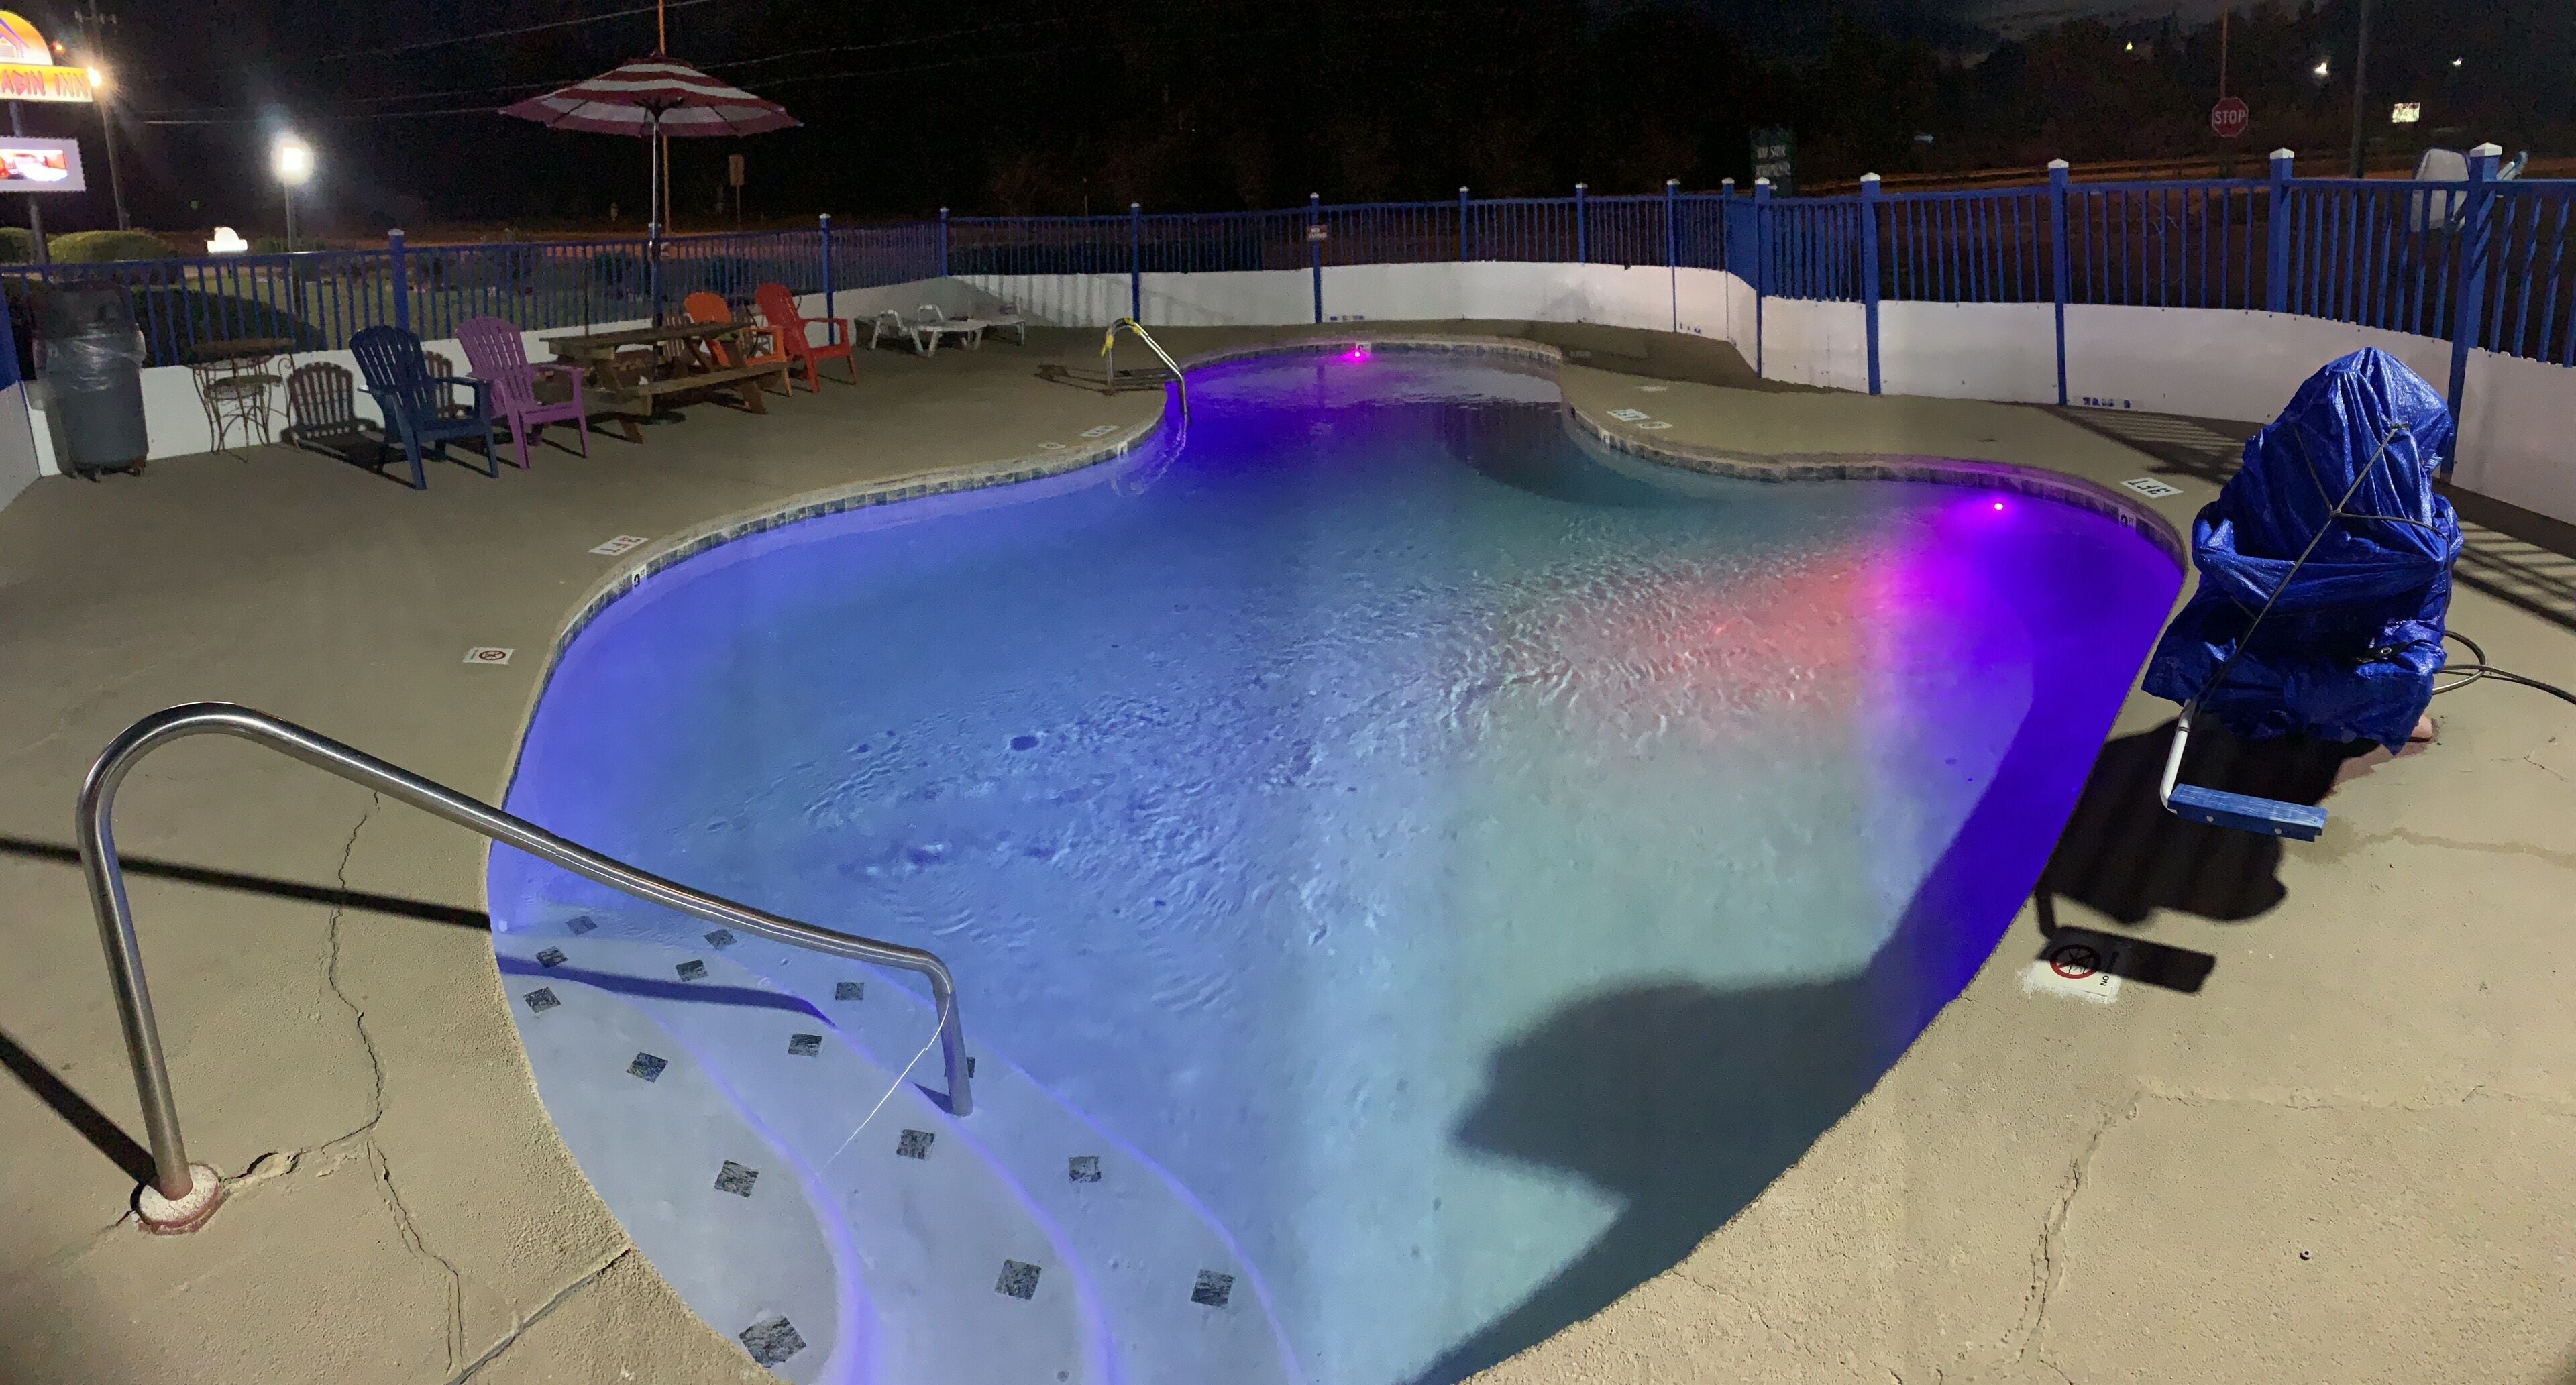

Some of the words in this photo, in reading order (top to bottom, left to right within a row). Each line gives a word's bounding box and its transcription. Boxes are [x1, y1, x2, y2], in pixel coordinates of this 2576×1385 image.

[54, 72, 88, 97] INN
[2214, 109, 2246, 125] STOP
[2100, 975, 2109, 986] NO
